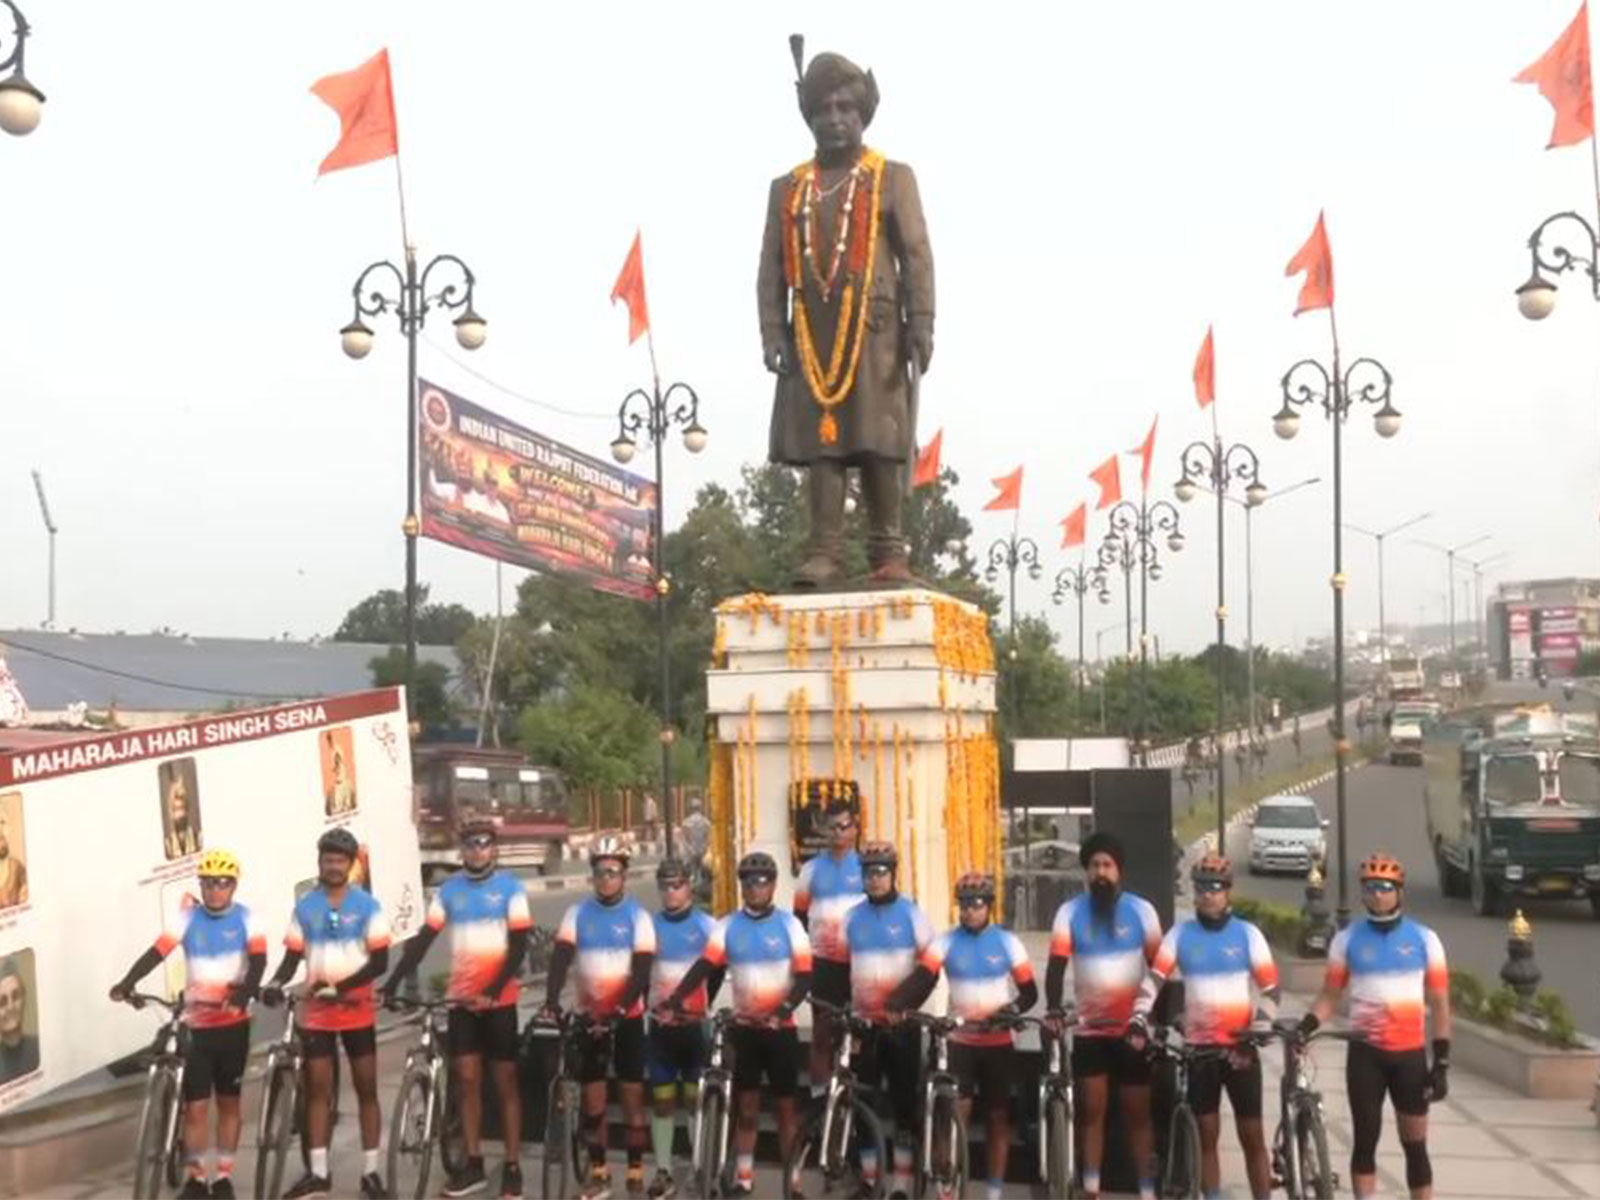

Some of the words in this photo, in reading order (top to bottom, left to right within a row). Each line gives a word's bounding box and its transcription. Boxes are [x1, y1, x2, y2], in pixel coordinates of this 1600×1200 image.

[459, 415, 497, 444] INDIAN
[498, 429, 535, 458] UNITED
[12, 735, 144, 779] MAHARAJA
[147, 728, 199, 753] HARI
[204, 716, 271, 743] SINGH
[274, 704, 327, 729] SENA
